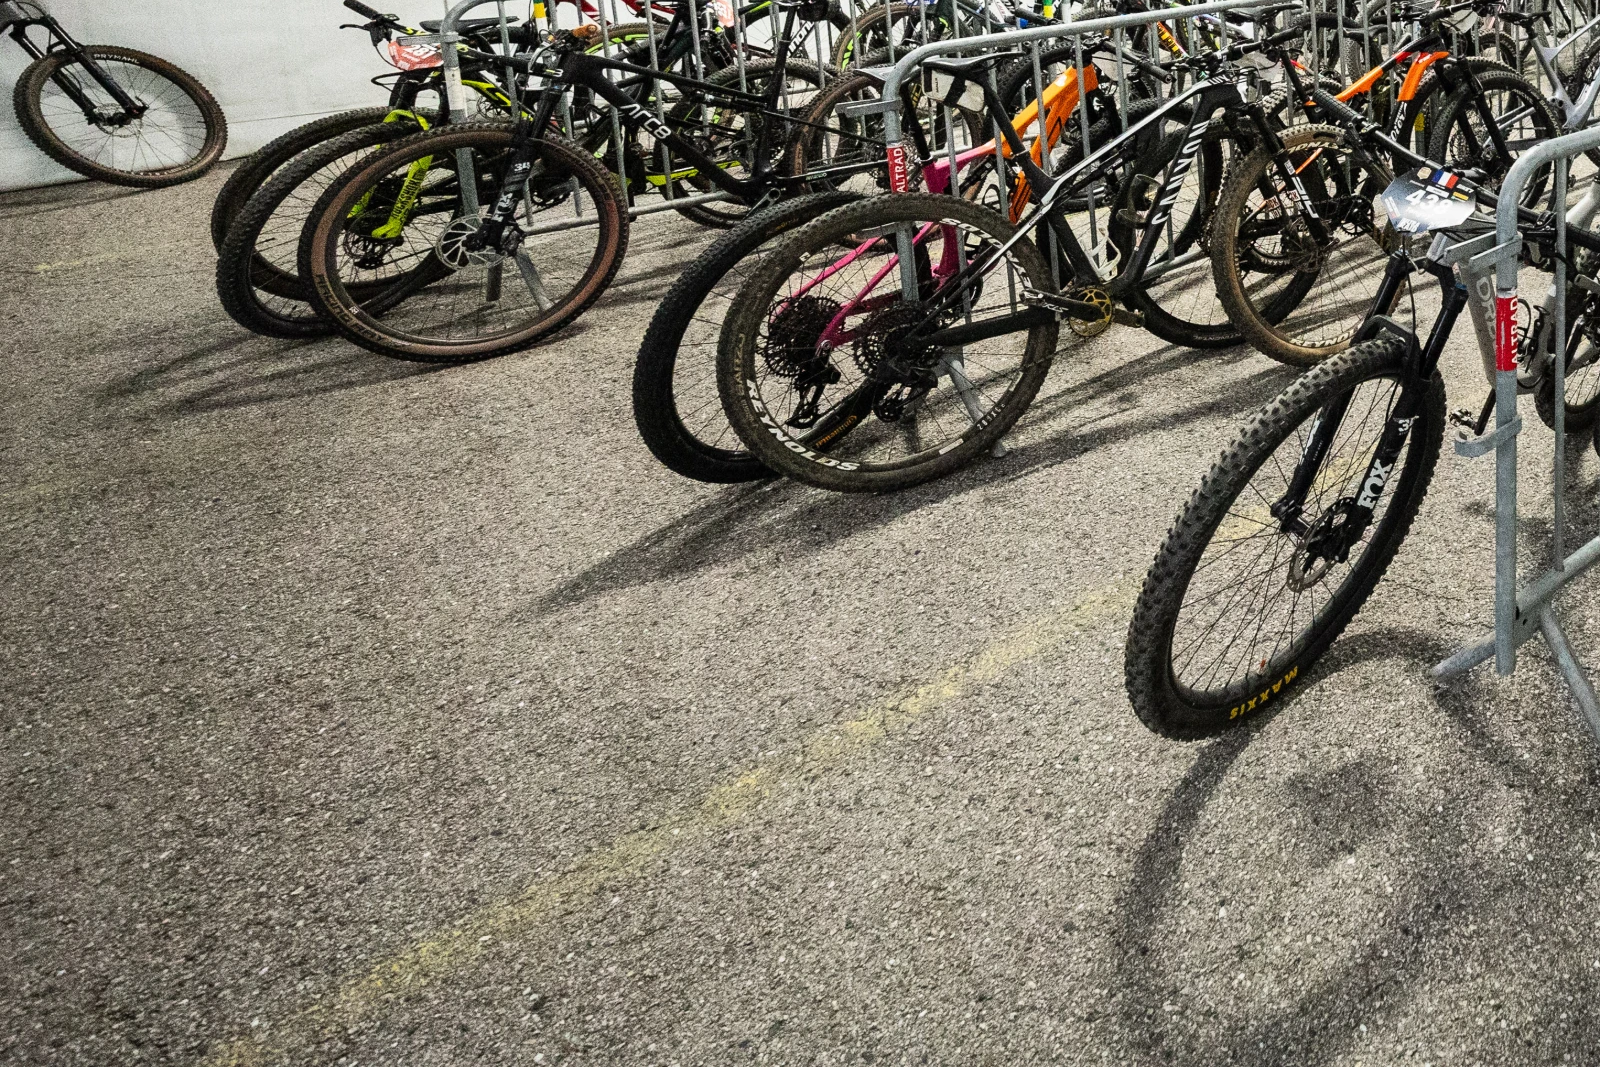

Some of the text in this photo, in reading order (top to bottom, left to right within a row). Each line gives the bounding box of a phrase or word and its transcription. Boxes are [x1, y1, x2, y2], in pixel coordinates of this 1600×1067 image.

[893, 147, 906, 193] ALTRAD
[1152, 120, 1210, 224] CANYON
[491, 192, 518, 222] FOX
[746, 379, 860, 471] REYNOLDS
[1356, 458, 1394, 510] FOX
[1229, 665, 1298, 720] MAXXIS
